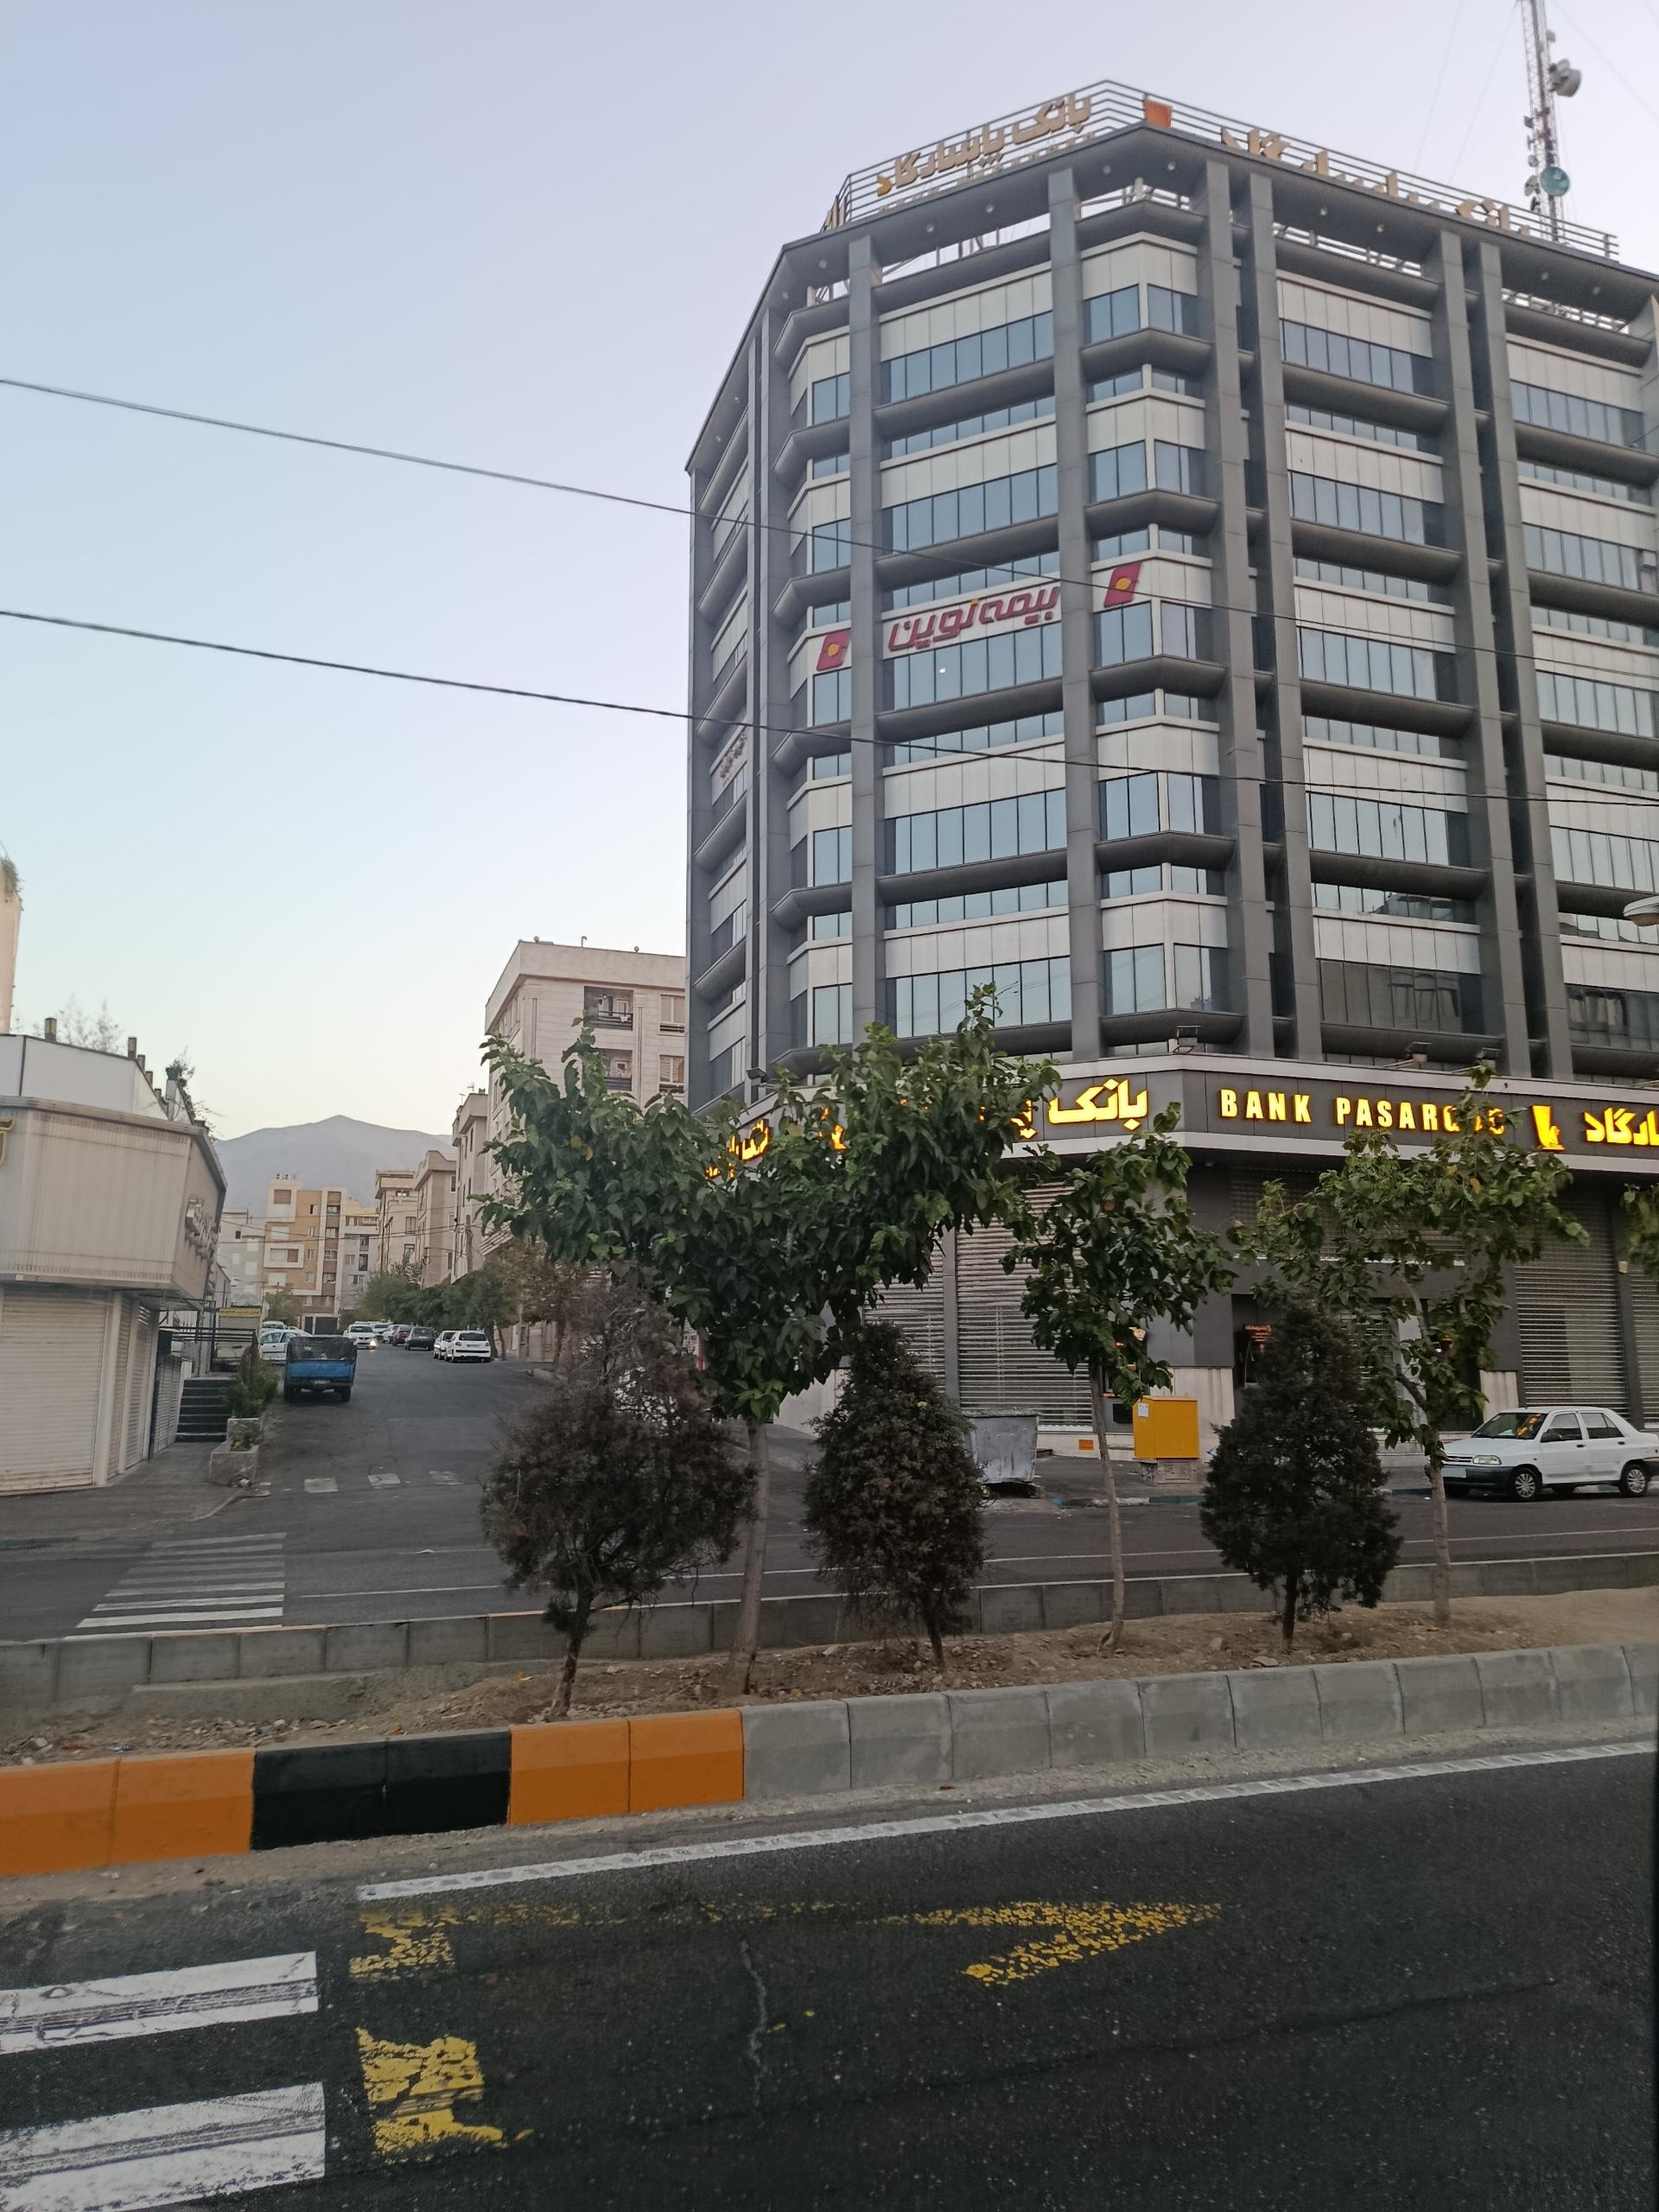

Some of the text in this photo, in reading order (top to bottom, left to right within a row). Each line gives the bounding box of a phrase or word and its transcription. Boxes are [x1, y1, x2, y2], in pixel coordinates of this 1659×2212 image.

[875, 92, 1092, 198] بانک پاسارگاد
[887, 585, 1060, 652] بیمه نوین
[1047, 1077, 1149, 1132] بانک
[1219, 1088, 1313, 1124] BANK
[1583, 1106, 1659, 1147] ارگاد
